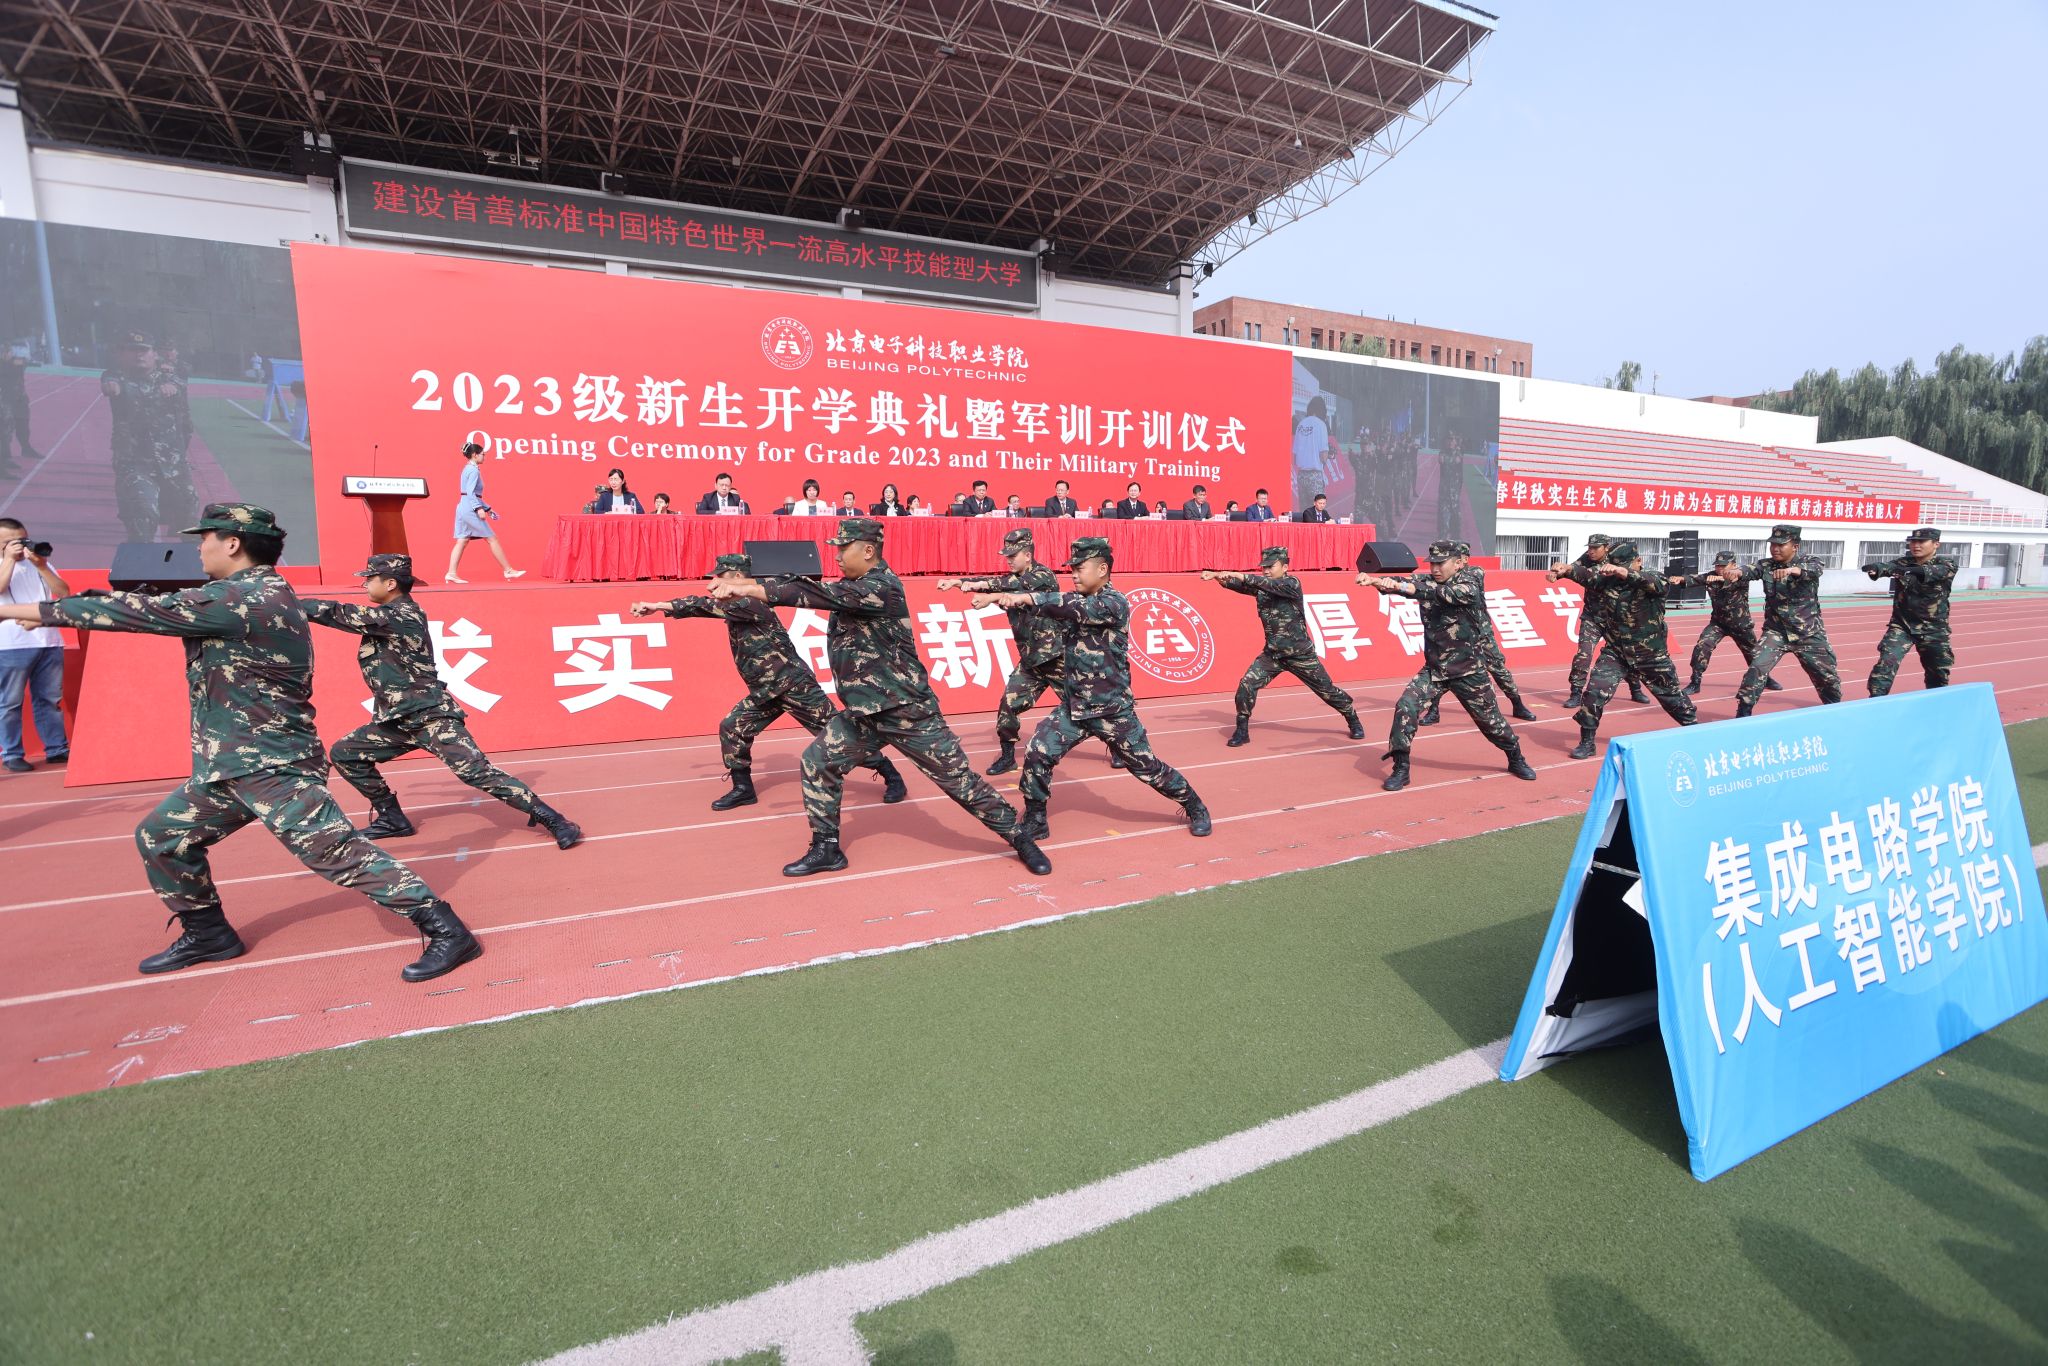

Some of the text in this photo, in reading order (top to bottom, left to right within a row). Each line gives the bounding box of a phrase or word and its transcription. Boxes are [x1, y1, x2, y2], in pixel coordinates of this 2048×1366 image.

[372, 180, 1022, 287] 建设首善标准中国特色世界一流高水平技能型大学
[825, 328, 1029, 369] 北京电子科技职业学院
[827, 358, 1027, 383] BEIJING POLYTECHNIC
[410, 369, 1247, 455] 2023级新生开学典礼暨军训开训仪式
[466, 430, 1222, 482] Opening Ceremony for Grade 2023 and Their Military Training
[1497, 480, 1904, 520] 春华秋实生生不息 努力成为全面发展的高素质劳动者和技术技能人才
[1165, 632, 1210, 678] POLYTECHNIC
[1708, 762, 1830, 796] BEIJING POLYTECHNIC
[1704, 775, 1994, 941] 集成电路学院
